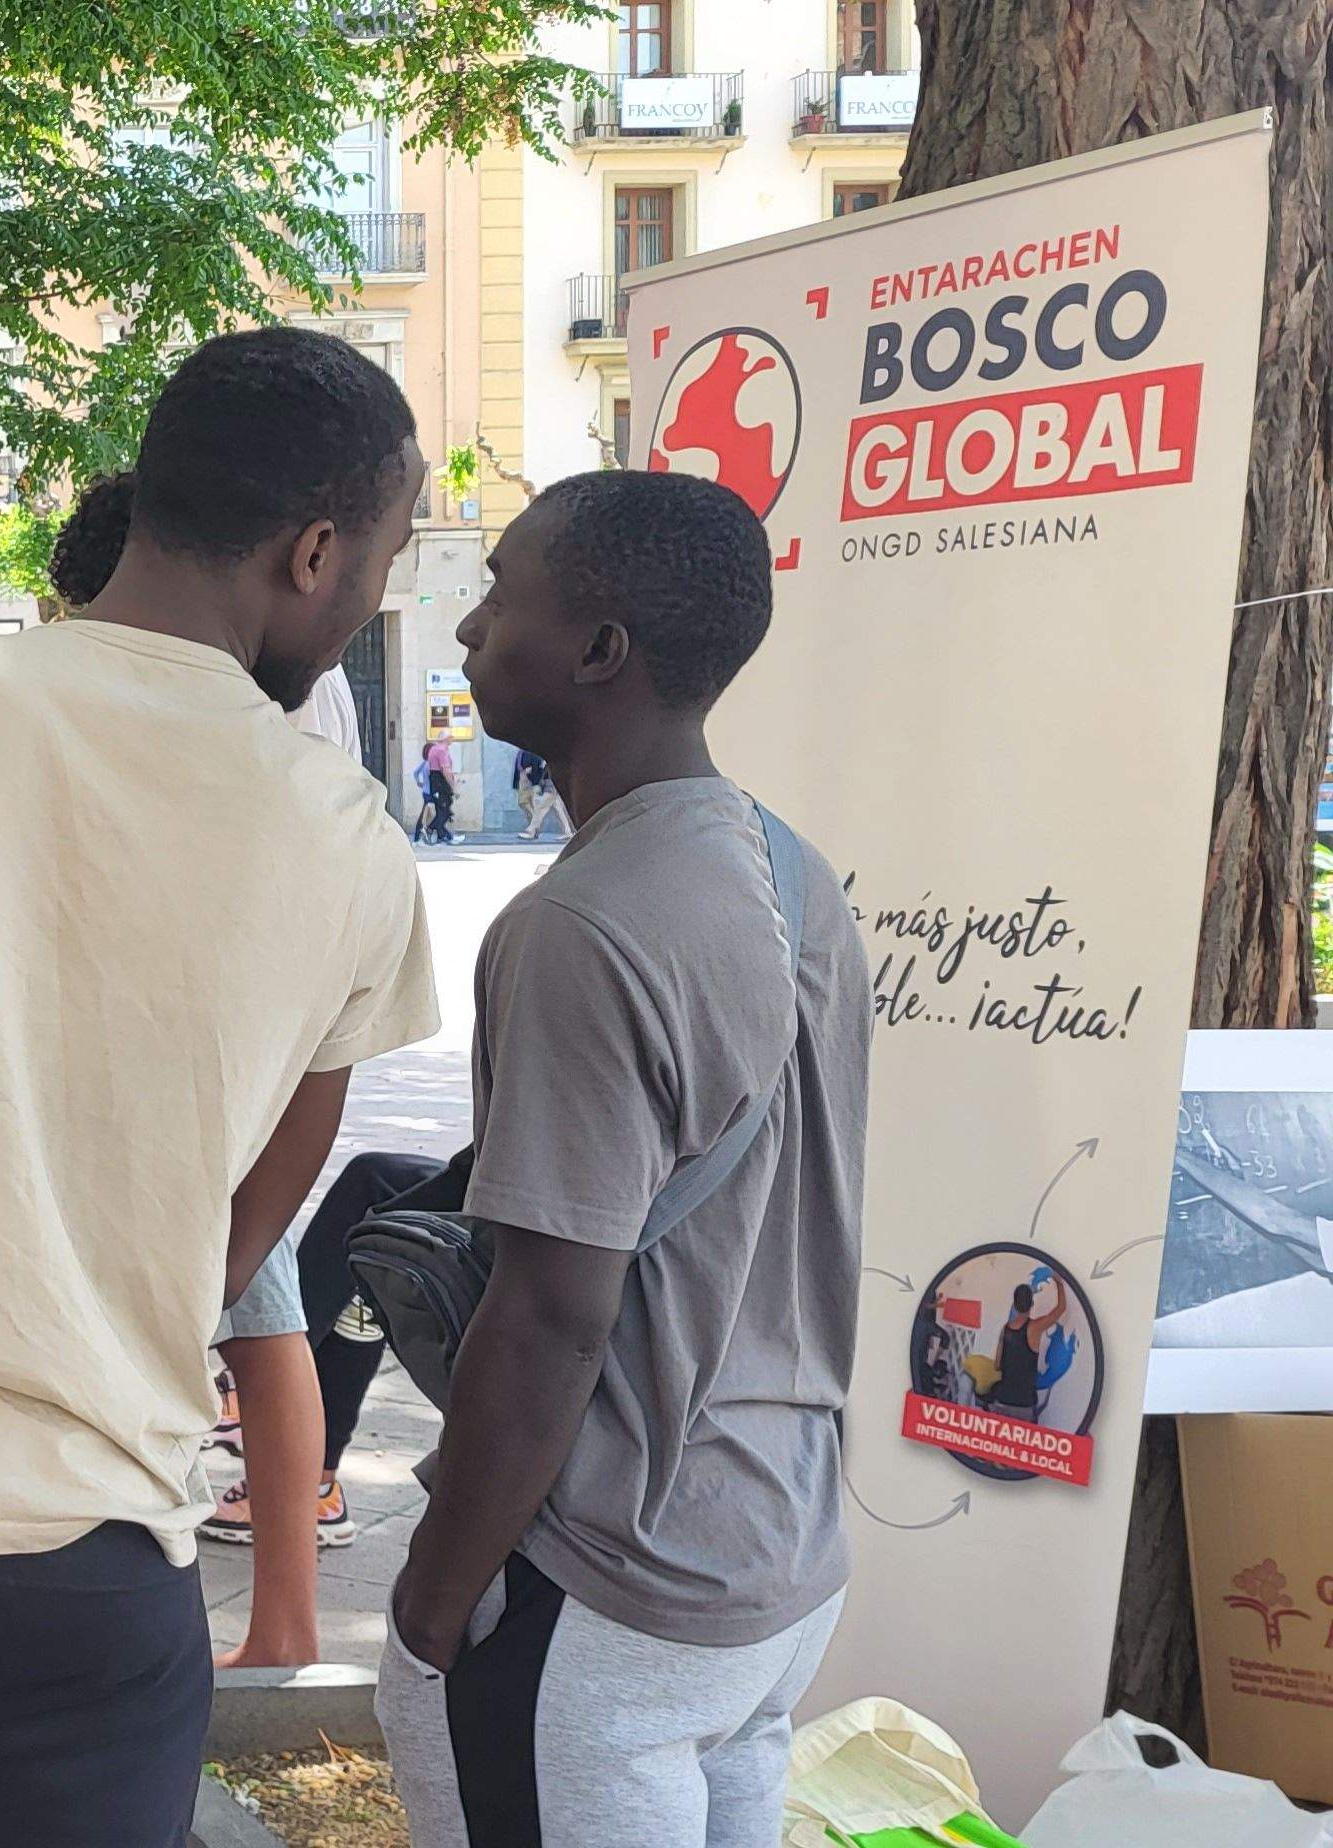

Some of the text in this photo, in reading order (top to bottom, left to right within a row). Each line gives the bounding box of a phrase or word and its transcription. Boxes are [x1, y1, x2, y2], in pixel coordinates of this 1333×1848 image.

[846, 100, 917, 115] FRANCO
[870, 224, 1120, 310] ENTARACHEN
[859, 268, 1168, 406] BOSCO
[849, 383, 1182, 509] GLOBAL
[841, 513, 1099, 563] ONGD SALESIANA
[874, 890, 955, 953] más
[936, 885, 1086, 985] justo,
[873, 952, 1143, 1045] ble... ¡actúa!
[916, 1422, 1018, 1460] INTERNACIONAL
[1031, 1454, 1073, 1476] LOCAL
[921, 1402, 1073, 1457] VOLUNTARIADO
